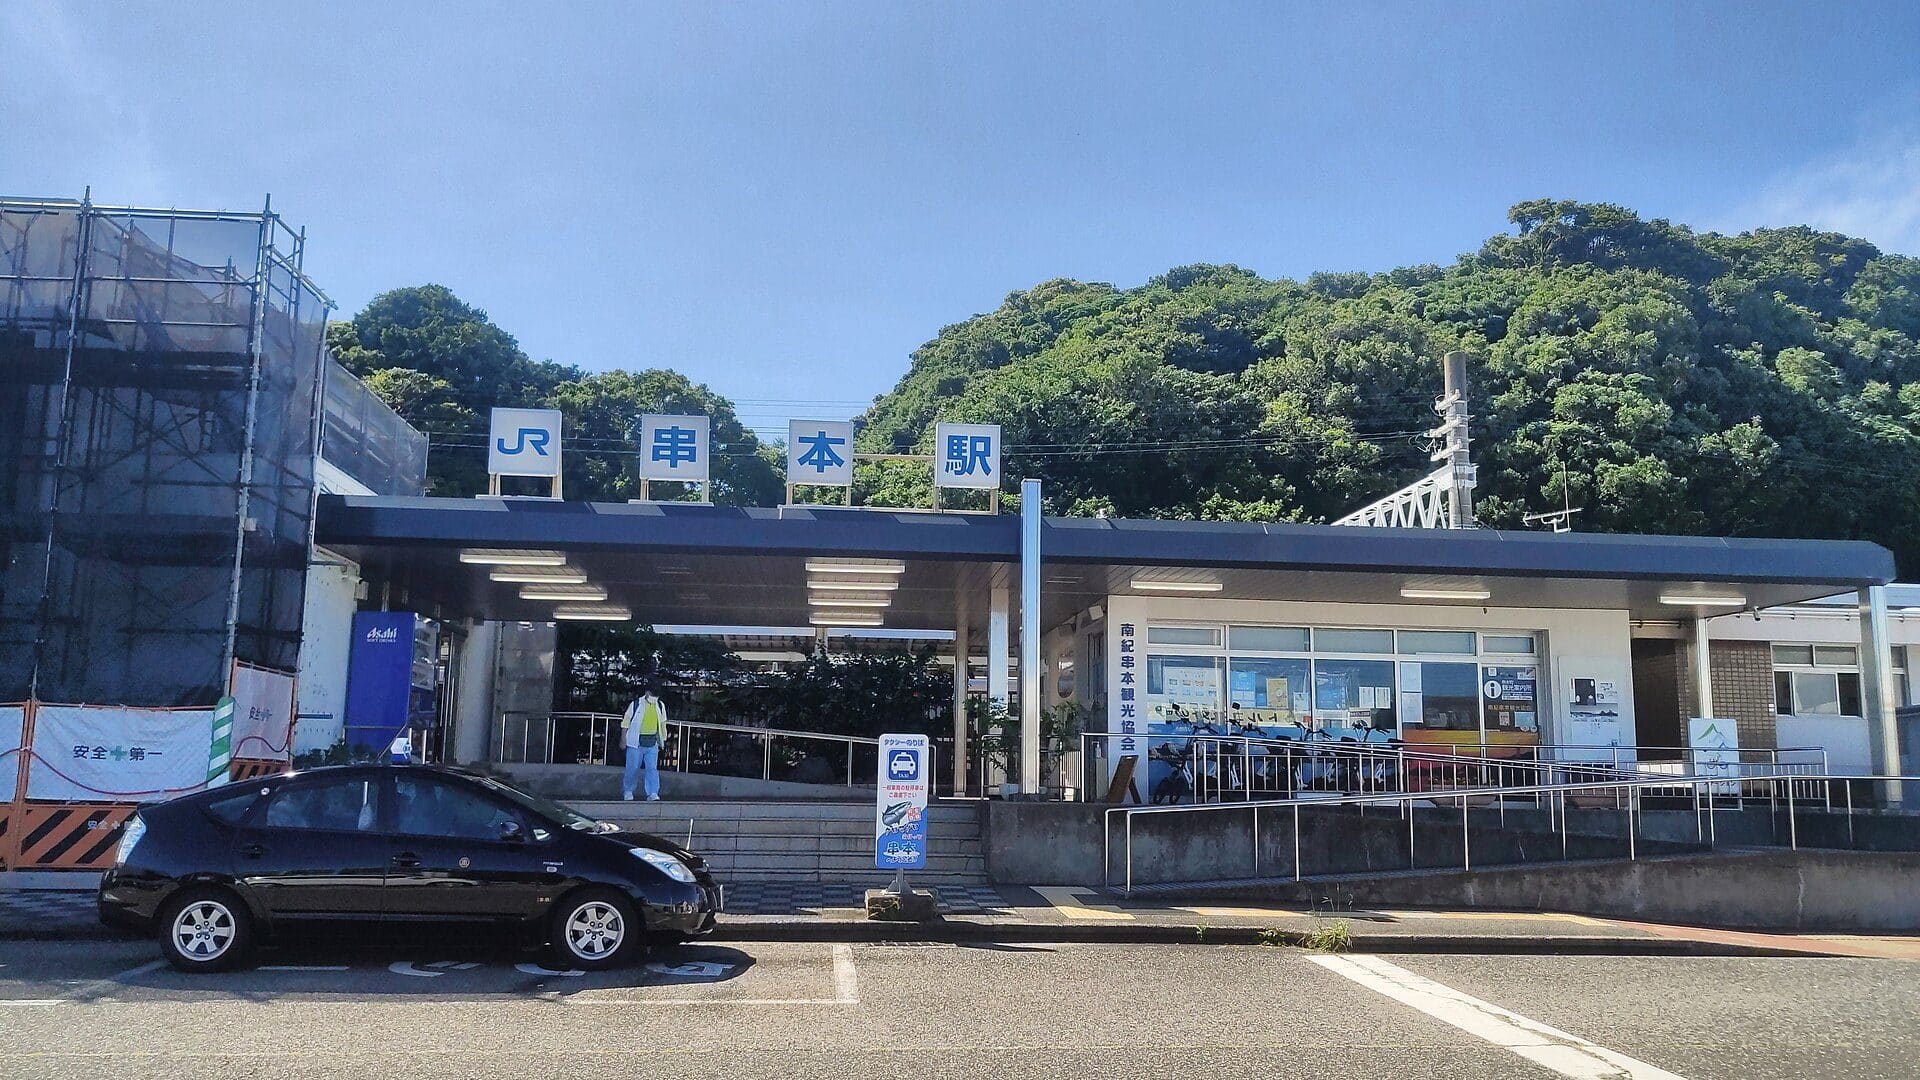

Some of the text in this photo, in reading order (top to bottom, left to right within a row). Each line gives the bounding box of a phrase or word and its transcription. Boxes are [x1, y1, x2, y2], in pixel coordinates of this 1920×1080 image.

[497, 428, 550, 456] JR
[366, 627, 398, 639] Asahi
[1120, 622, 1136, 751] 南紀串本観光協会
[884, 738, 925, 747] タクシーのりば
[887, 841, 917, 855] 串本
